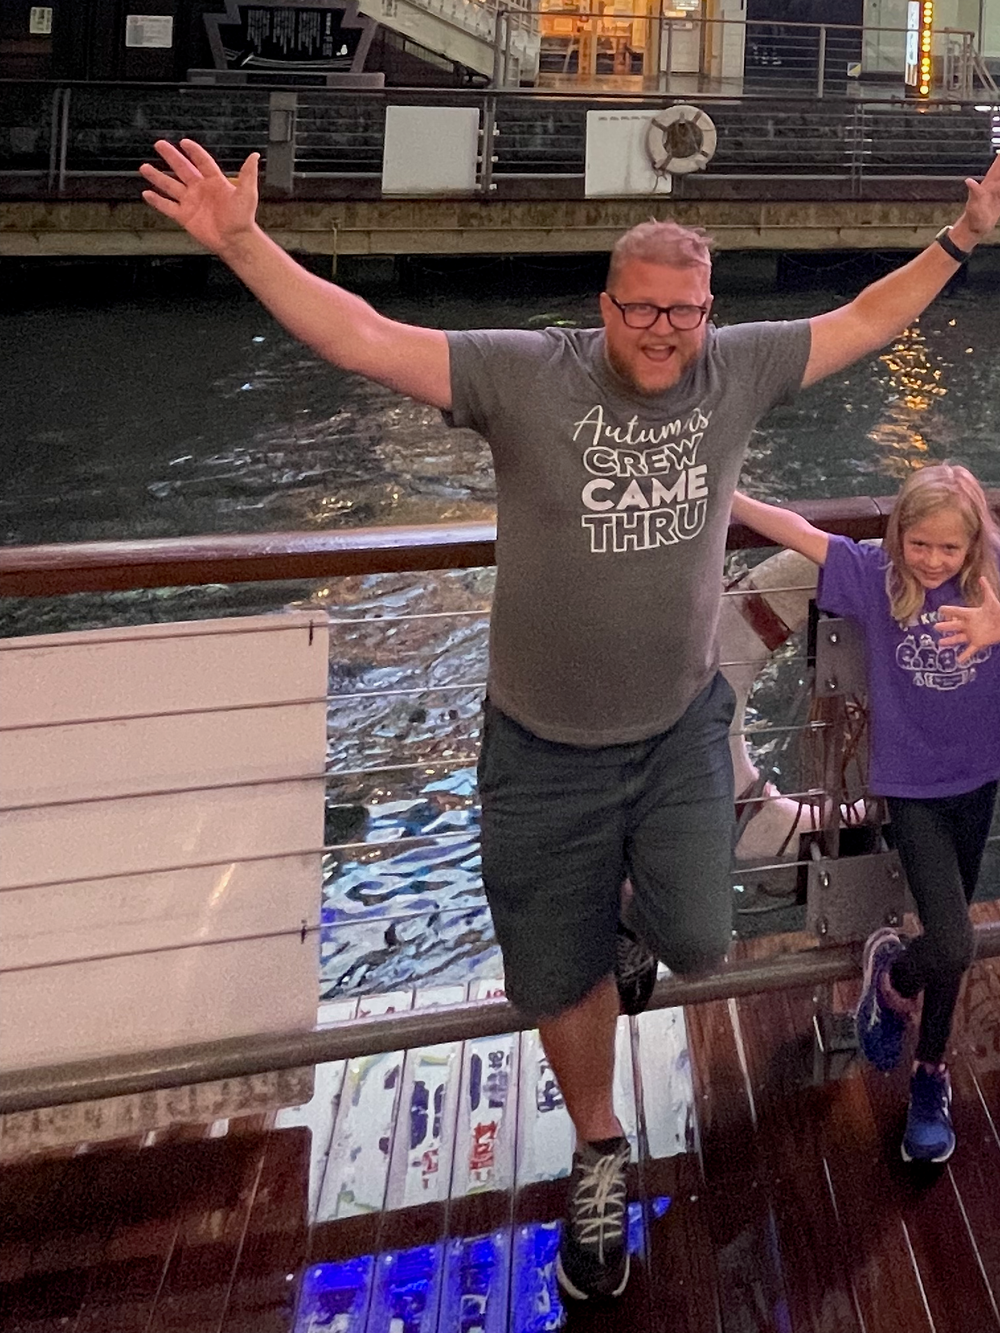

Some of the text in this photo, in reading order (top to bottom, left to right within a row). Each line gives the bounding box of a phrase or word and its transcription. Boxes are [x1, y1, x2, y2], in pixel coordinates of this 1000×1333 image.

[583, 432, 704, 477] CREW
[582, 464, 709, 511] CAME
[582, 499, 707, 553] THRU
